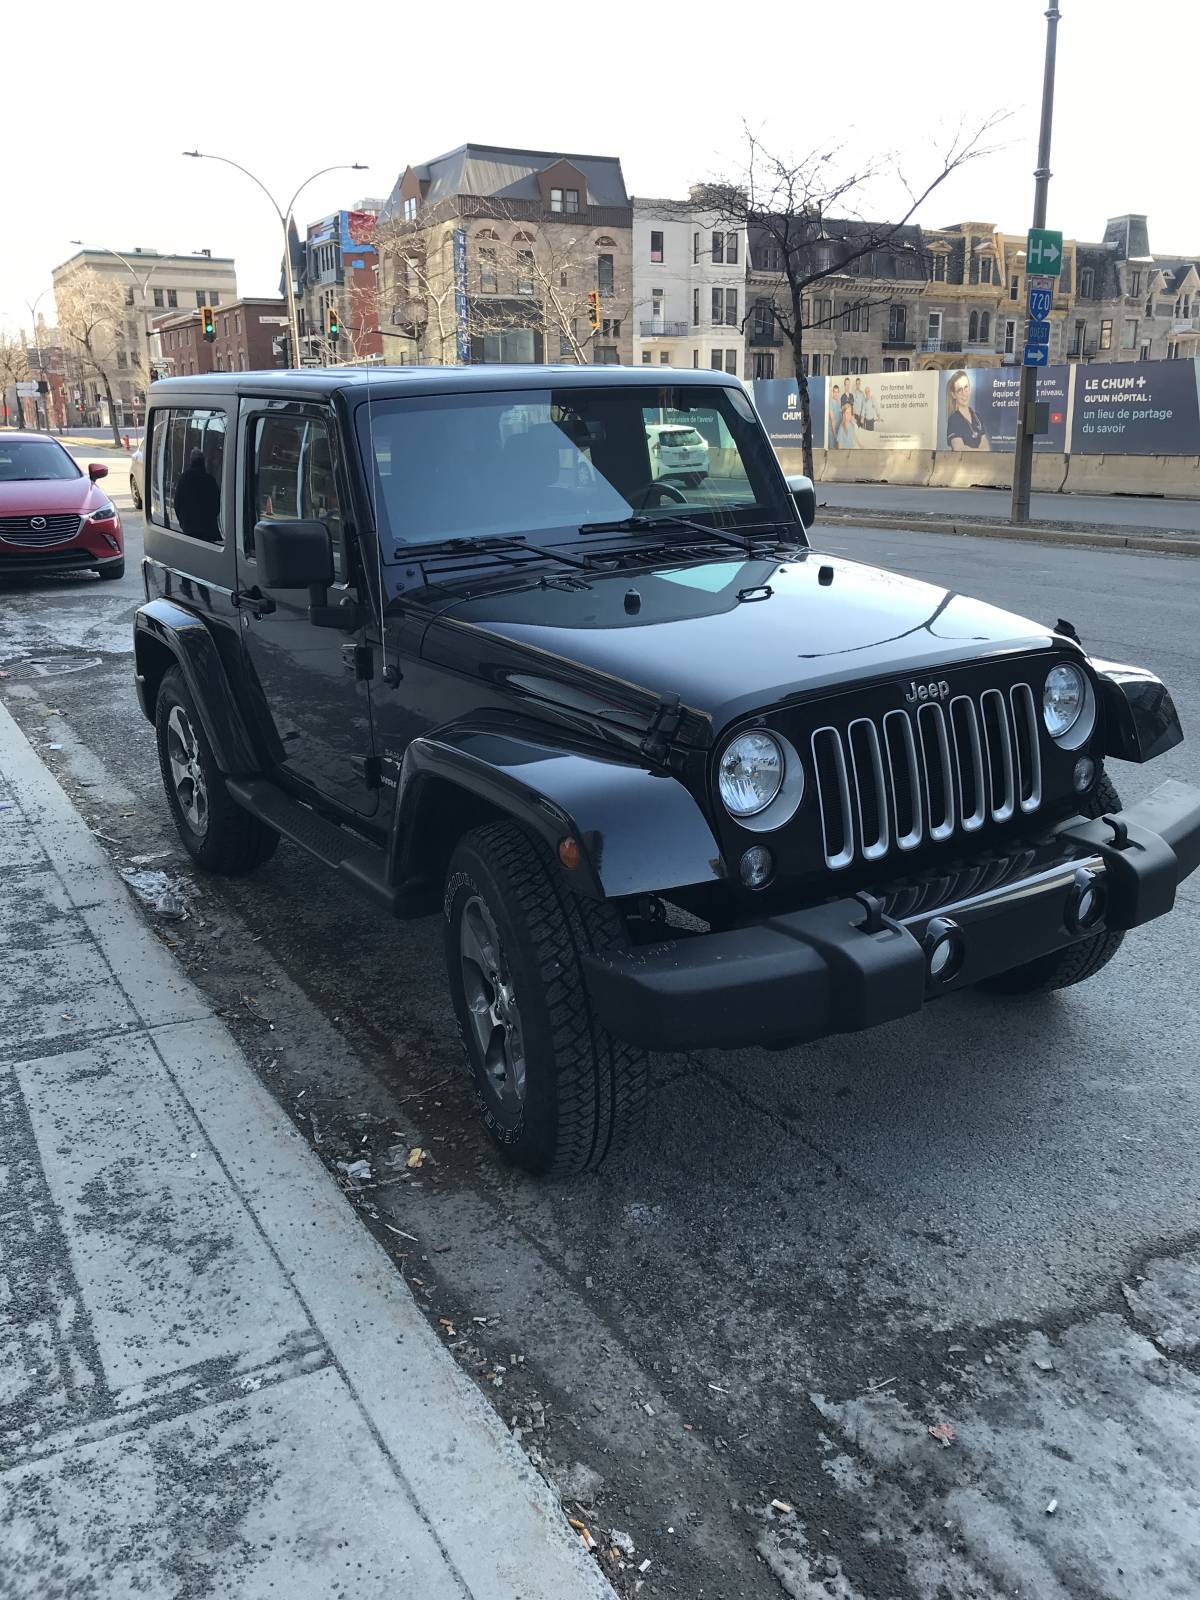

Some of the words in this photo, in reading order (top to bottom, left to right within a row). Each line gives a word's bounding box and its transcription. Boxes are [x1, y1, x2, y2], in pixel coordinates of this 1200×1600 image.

[1029, 239, 1042, 265] H
[1032, 293, 1050, 310] 720
[1029, 326, 1048, 338] OUEST
[993, 379, 1006, 388] Être
[1085, 379, 1099, 389] LE
[1101, 378, 1134, 389] CHUM
[992, 390, 1014, 398] équipe
[1084, 394, 1110, 402] QU'UN
[782, 411, 801, 421] CHUM
[1083, 410, 1095, 419] un
[1097, 408, 1114, 419] lieu
[1117, 408, 1130, 419] de
[1132, 409, 1173, 420] partage
[1082, 423, 1094, 433] du
[1096, 423, 1126, 433] savoir
[905, 680, 950, 703] Jeep
